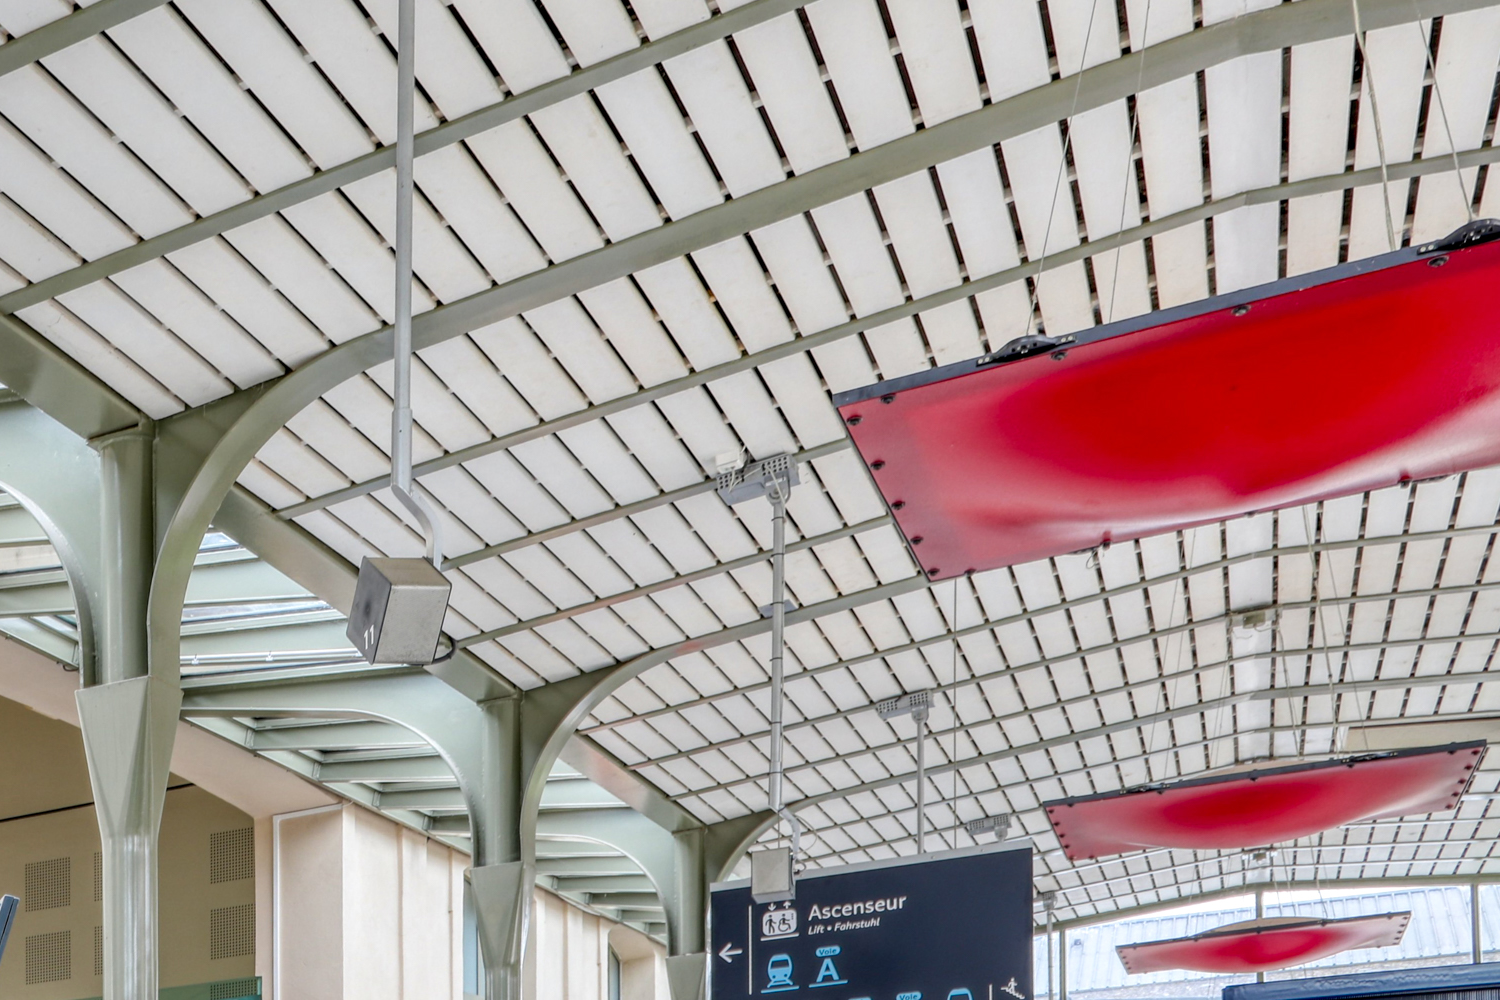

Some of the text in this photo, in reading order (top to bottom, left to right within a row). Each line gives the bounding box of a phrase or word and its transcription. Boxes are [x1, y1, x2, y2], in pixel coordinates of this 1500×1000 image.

[363, 624, 375, 650] 11
[808, 896, 907, 921] Ascenseur
[808, 917, 880, 935] Lift Fahrstuhl
[819, 948, 837, 956] Voie
[816, 958, 840, 983] A
